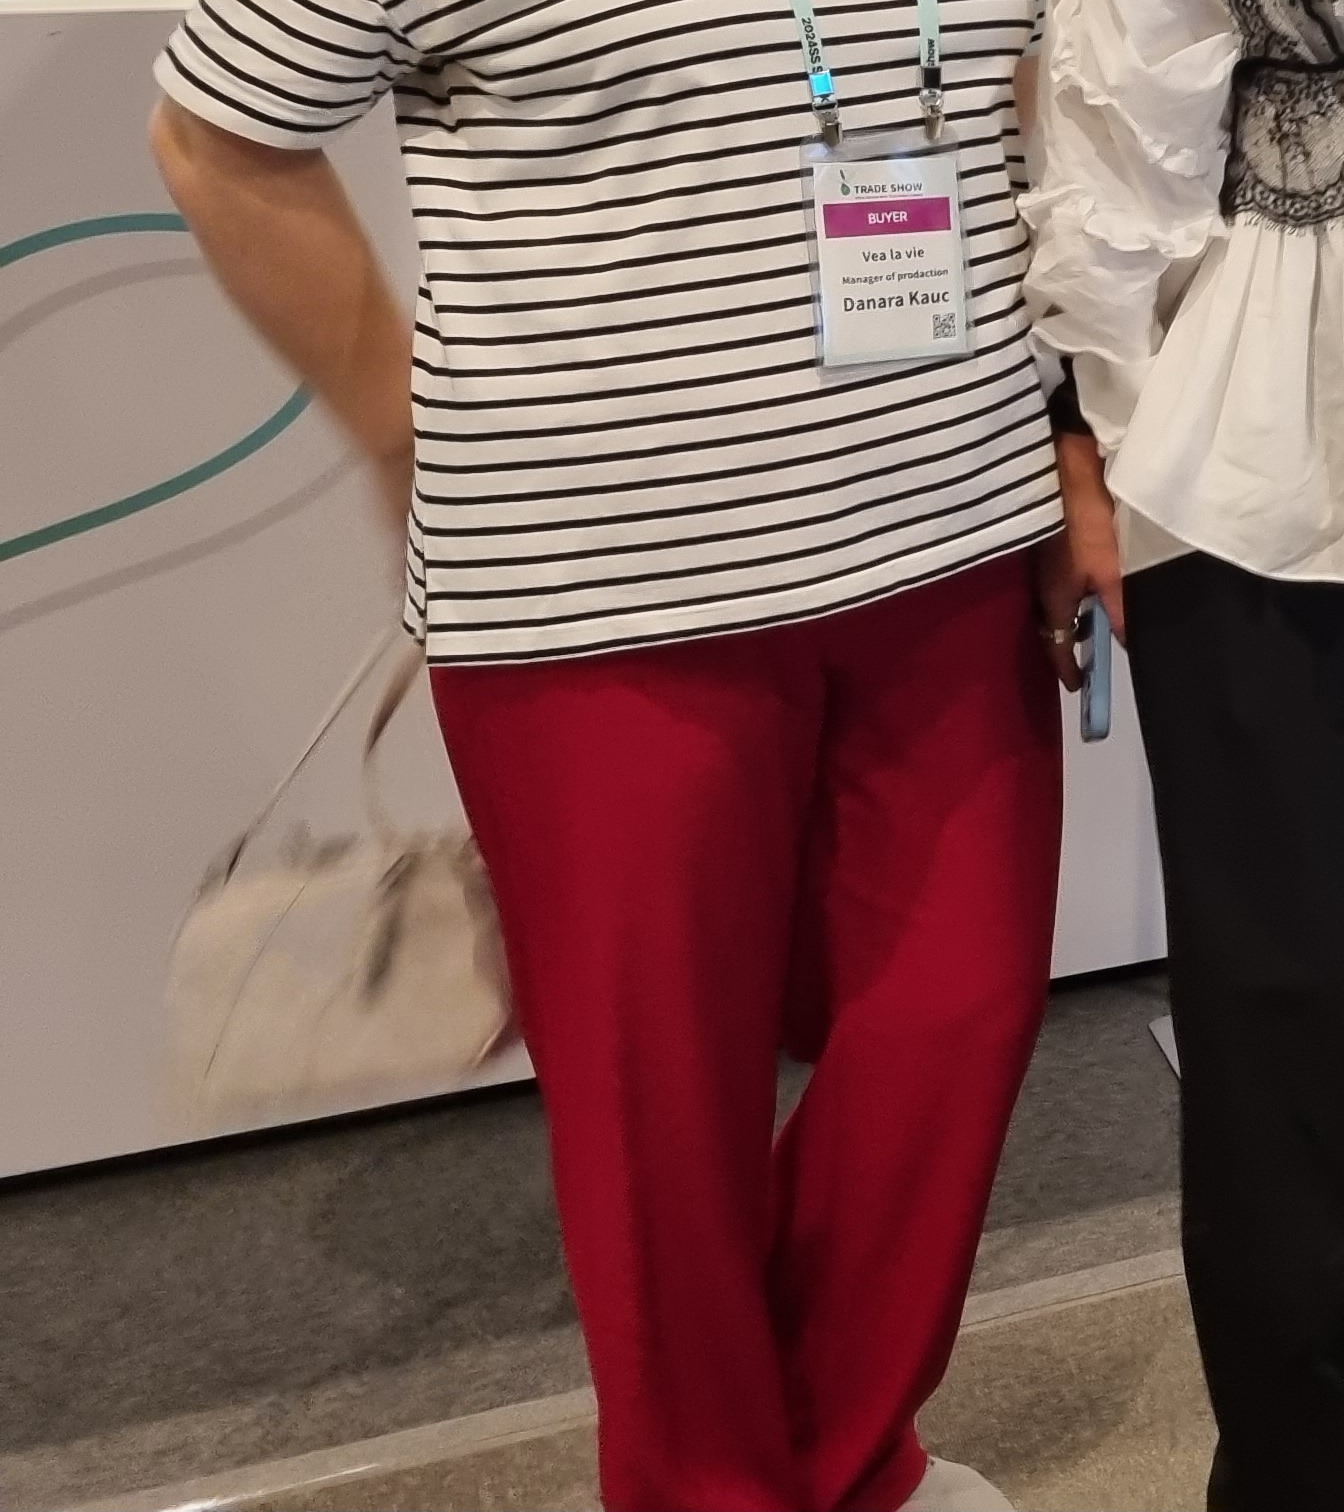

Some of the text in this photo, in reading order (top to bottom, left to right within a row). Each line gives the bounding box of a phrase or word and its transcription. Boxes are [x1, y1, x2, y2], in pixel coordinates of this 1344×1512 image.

[801, 16, 820, 64] 2024SS
[854, 182, 923, 194] TRADE SHOW
[867, 211, 908, 225] BUYER
[862, 246, 925, 263] Vea la vie
[842, 274, 883, 285] Manager
[885, 272, 895, 281] of
[843, 290, 950, 312] Danara Kauc
